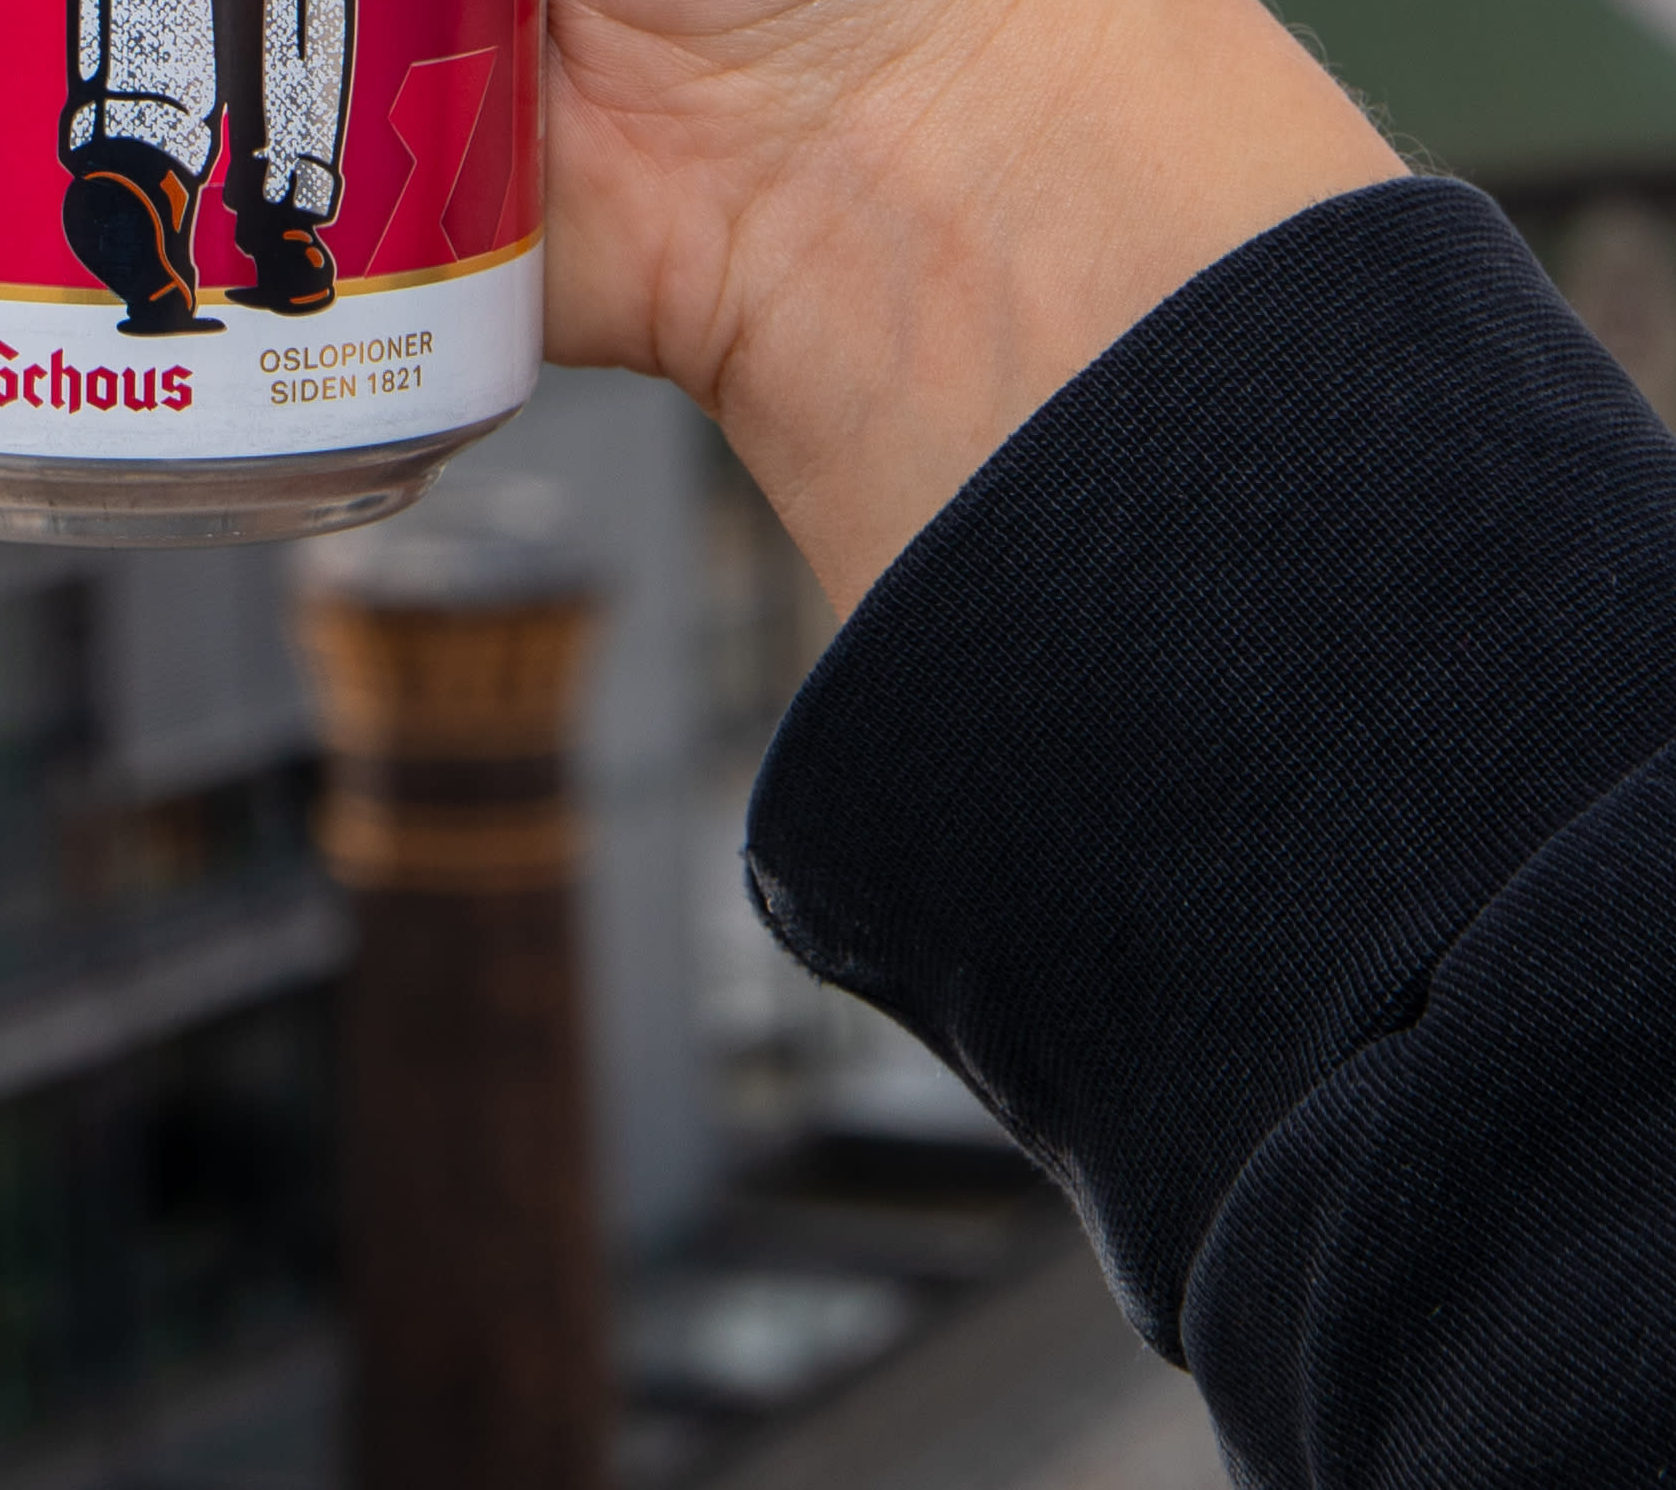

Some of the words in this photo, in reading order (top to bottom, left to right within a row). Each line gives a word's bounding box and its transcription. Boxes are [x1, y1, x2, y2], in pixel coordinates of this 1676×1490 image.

[259, 330, 434, 374] OSLOPIONER
[270, 373, 357, 405] SIDEN
[366, 364, 422, 396] 1821
